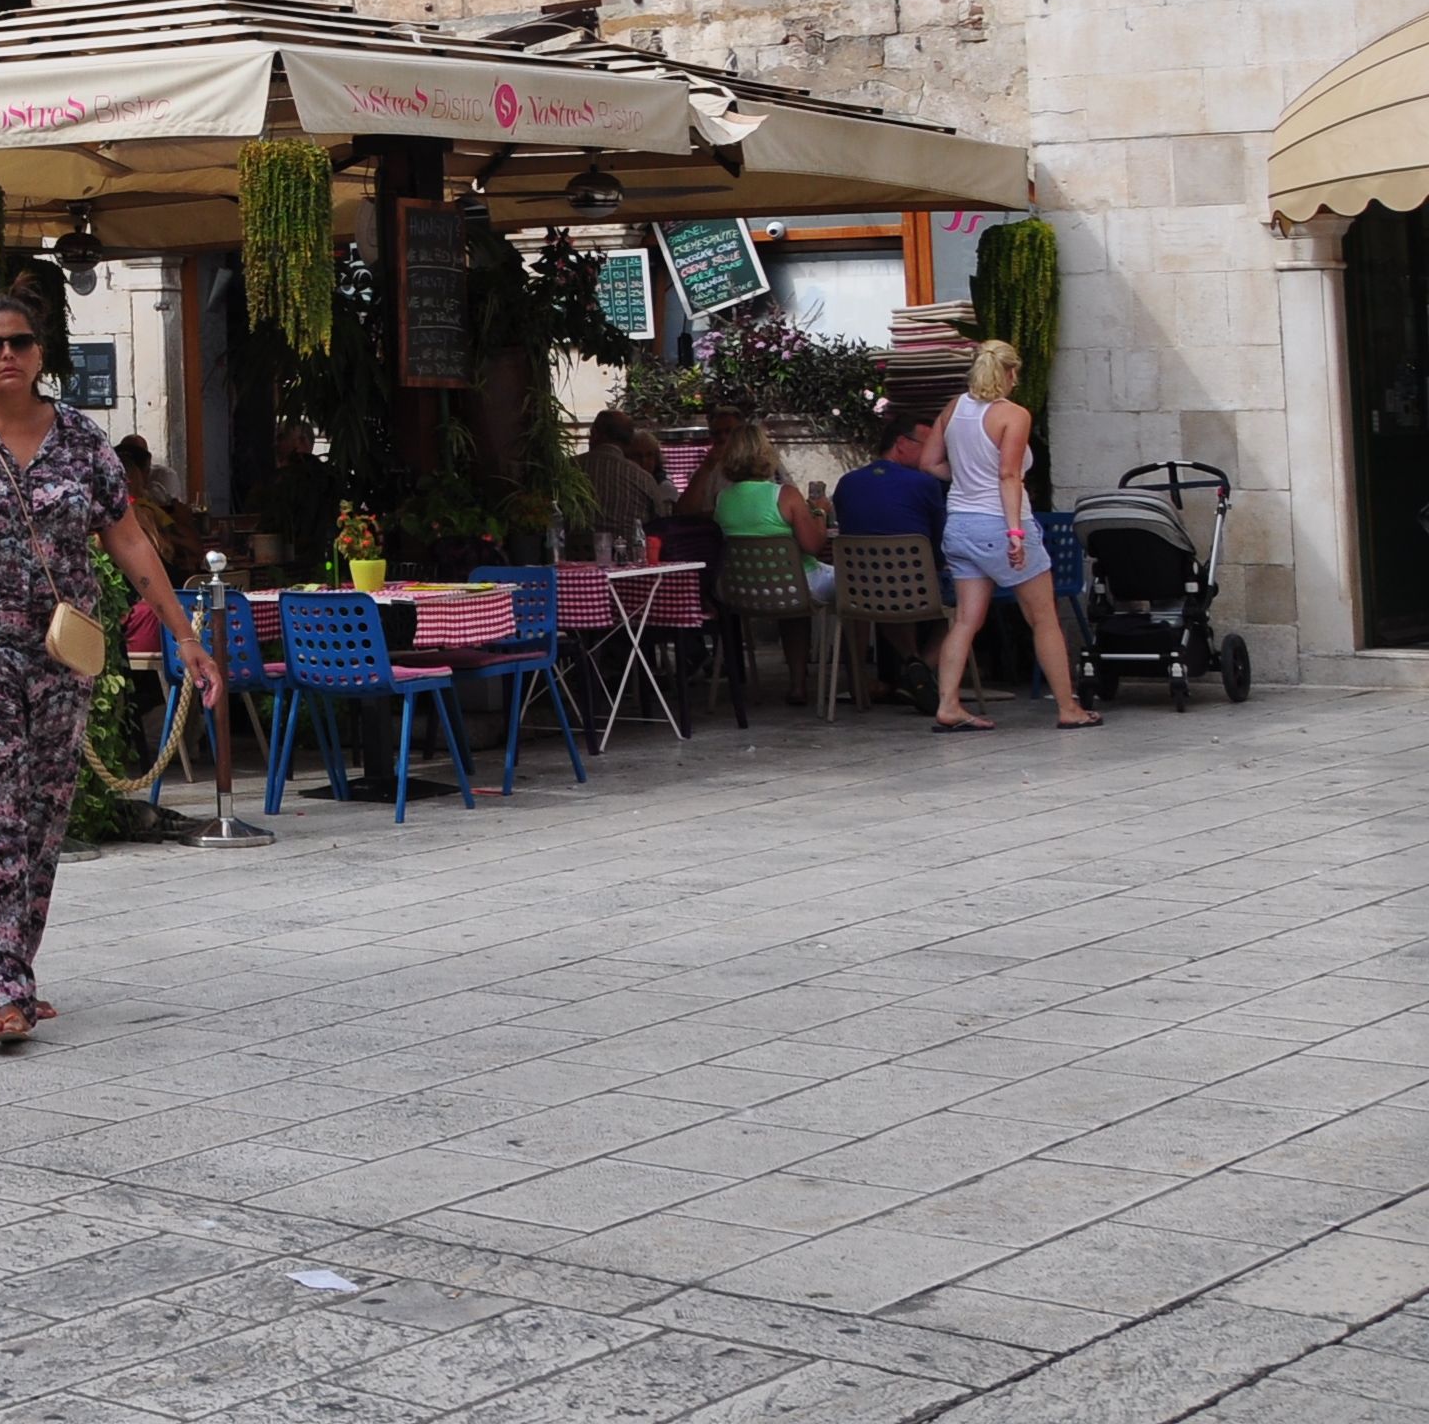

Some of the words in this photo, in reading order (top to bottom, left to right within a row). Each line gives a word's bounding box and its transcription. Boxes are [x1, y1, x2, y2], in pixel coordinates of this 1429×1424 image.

[93, 94, 172, 125] Bistro
[431, 88, 484, 122] Bistro
[597, 100, 643, 131] Bistro
